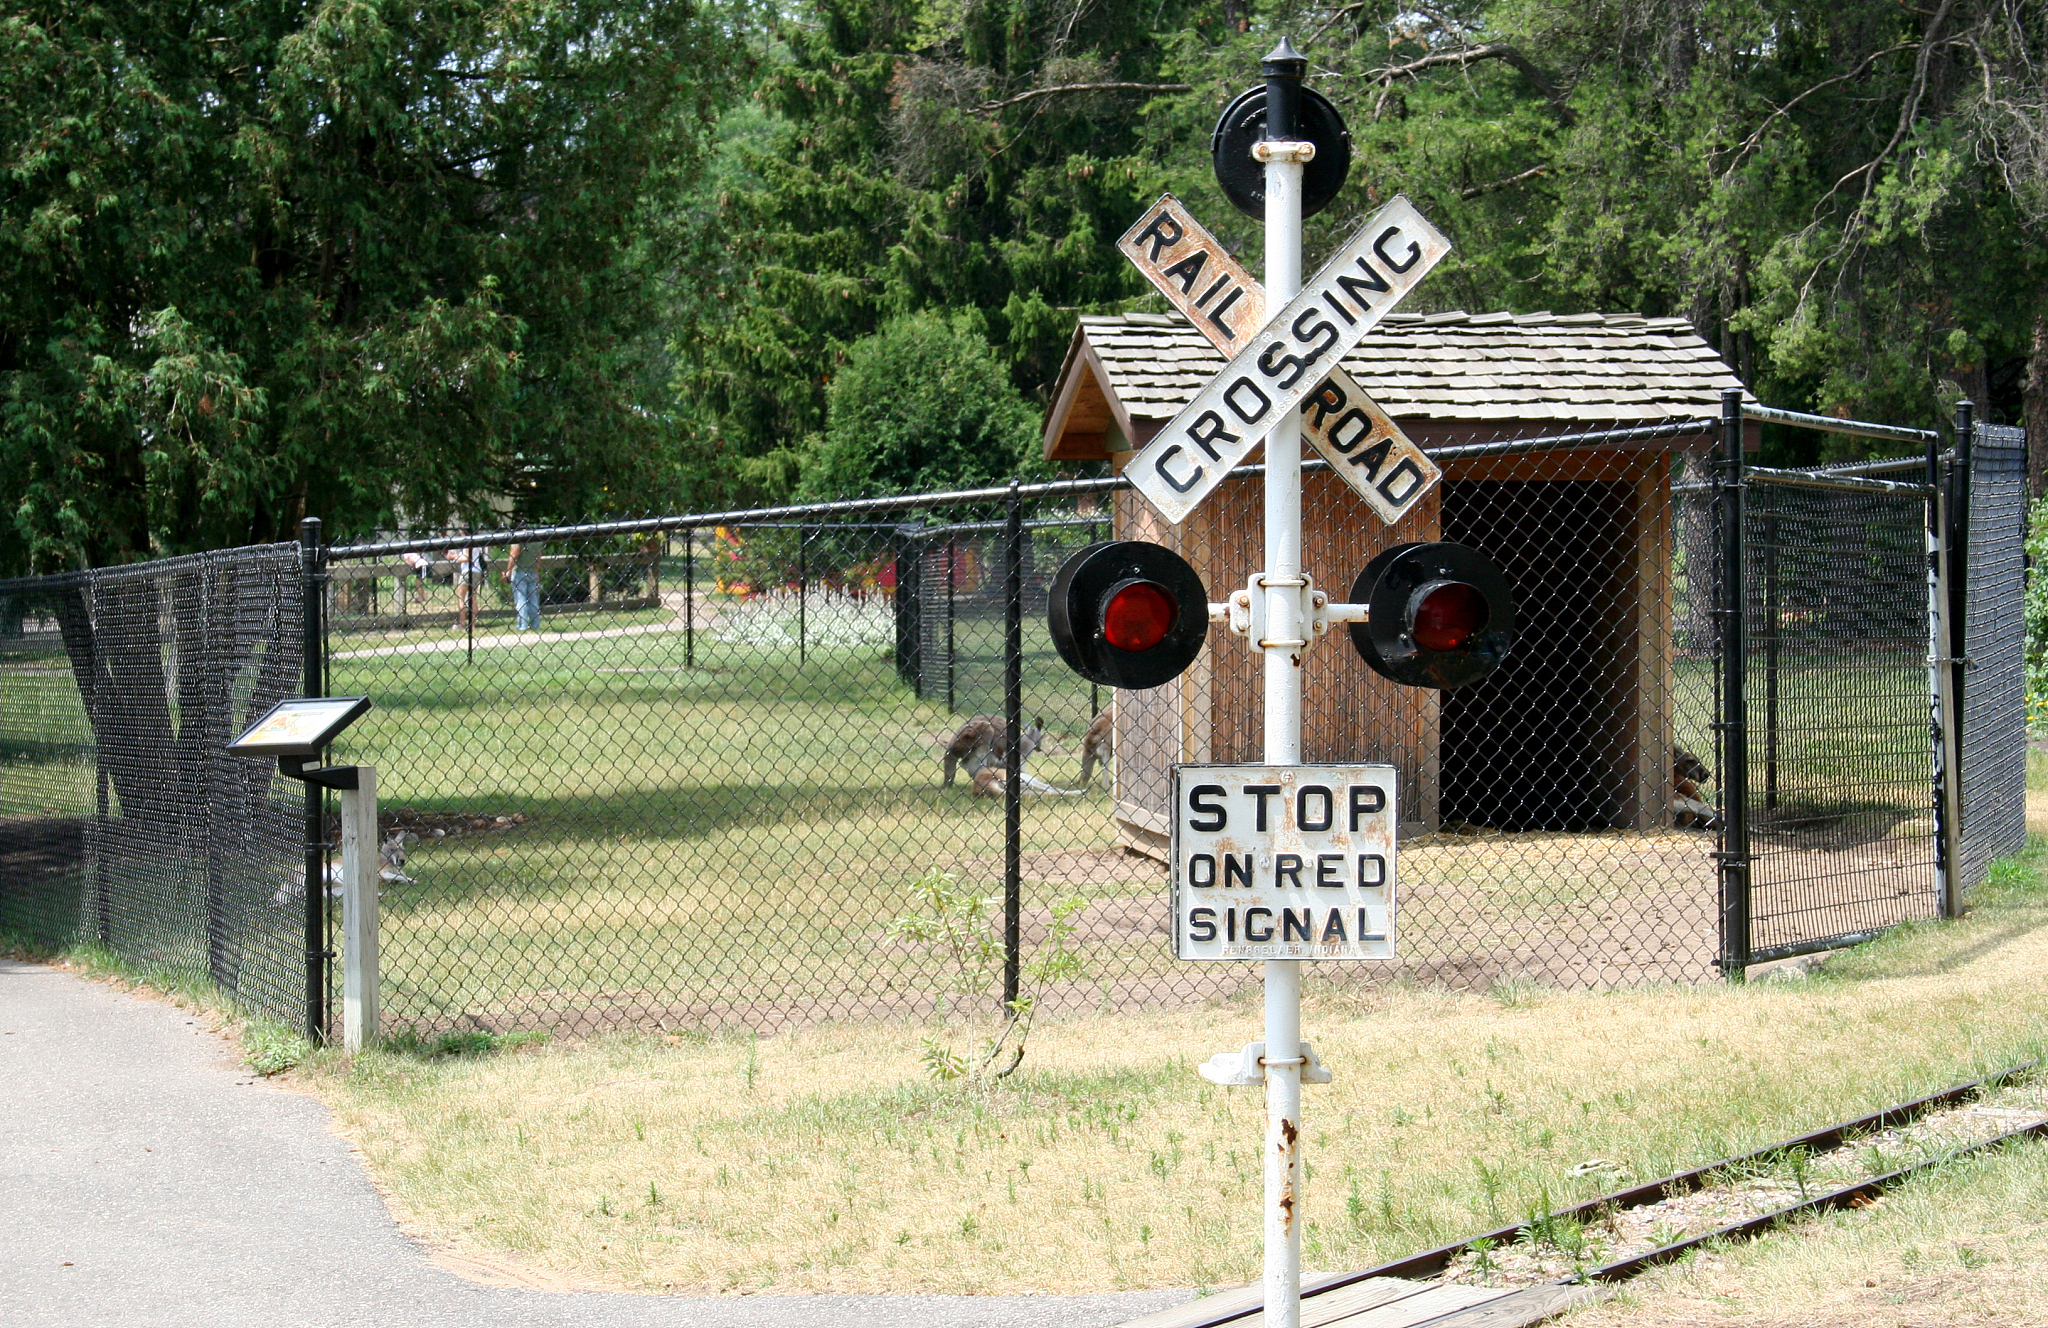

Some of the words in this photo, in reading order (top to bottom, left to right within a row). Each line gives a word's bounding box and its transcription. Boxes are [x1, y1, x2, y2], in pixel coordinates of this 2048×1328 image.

[1133, 210, 1245, 341] RAIL
[1301, 378, 1426, 508] ROAD
[1155, 226, 1422, 494] CROSSING
[1261, 369, 1320, 428] RENSSELAER
[1188, 784, 1386, 832] STOP
[1188, 853, 1253, 888] ON
[1275, 853, 1386, 888] RED
[1188, 907, 1386, 942] SIGNAL
